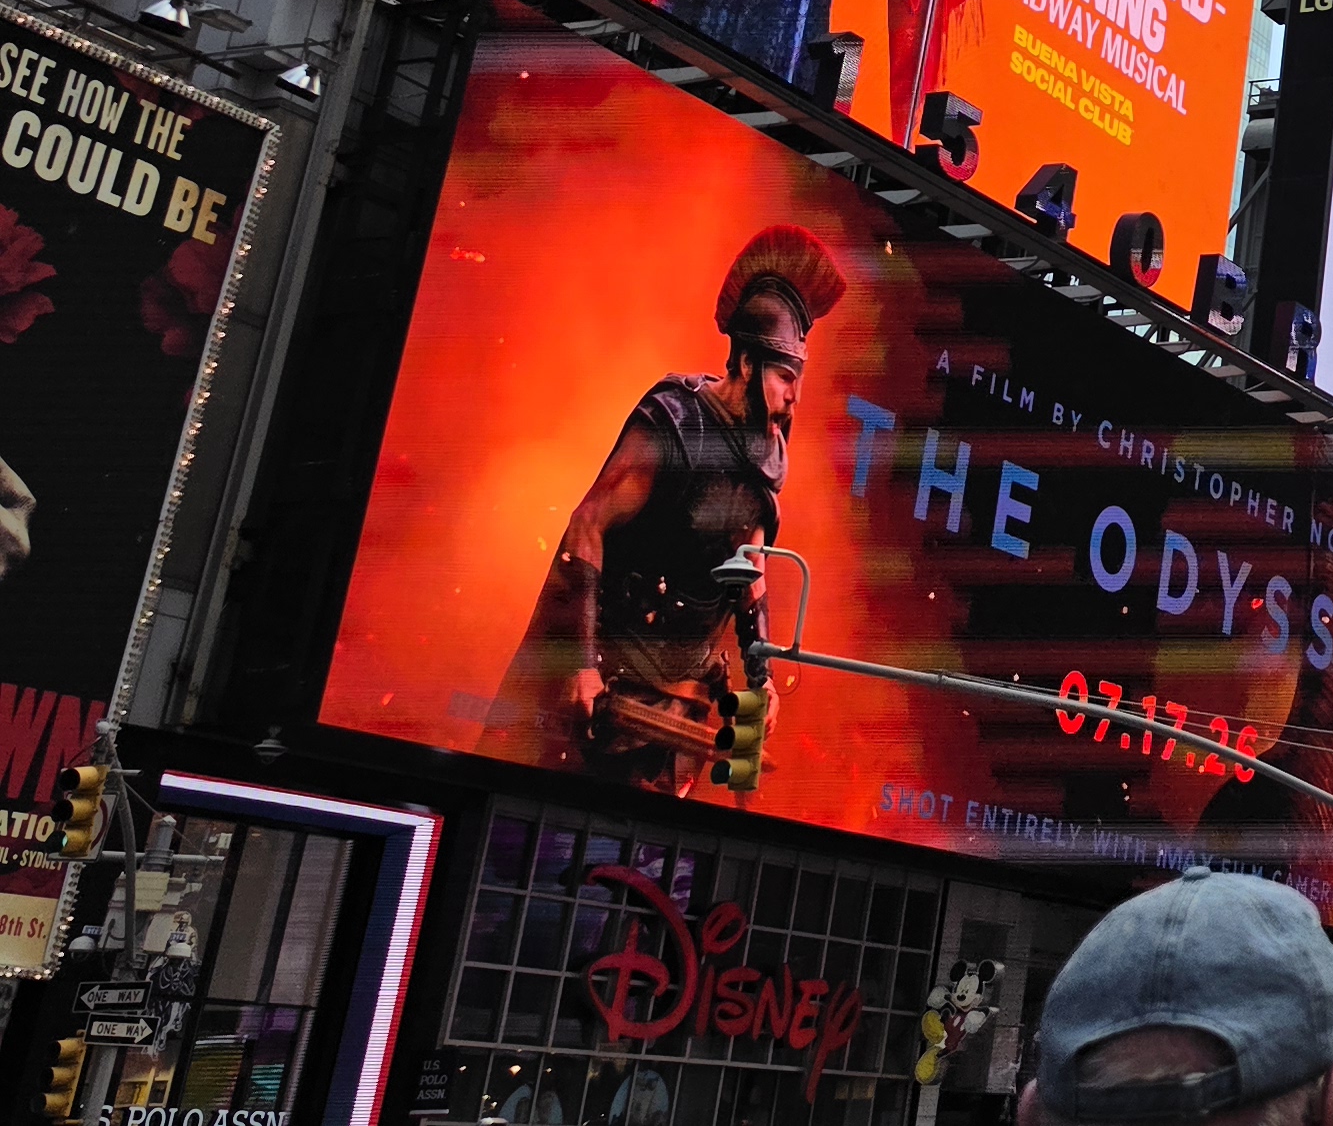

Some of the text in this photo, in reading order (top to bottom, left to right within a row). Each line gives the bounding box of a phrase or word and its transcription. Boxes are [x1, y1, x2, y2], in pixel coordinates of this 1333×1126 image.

[0, 42, 193, 161] SEE HOW THE
[1009, 50, 1132, 147] SOCIAL CLUB
[1013, 24, 1134, 123] BUENA VISTA
[1102, 26, 1188, 116] MUSICAL
[2, 109, 228, 246] COULD BE
[808, 30, 1166, 289] 1540
[846, 394, 1040, 560] THE
[936, 348, 950, 375] A
[972, 364, 1035, 413] FILM
[1052, 401, 1083, 433] BY
[1097, 419, 1296, 534] CHRISTOPHER
[880, 782, 954, 822] SHOT
[966, 800, 1083, 852] ENTIRELY
[1092, 826, 1148, 864] WITH
[27, 922, 47, 940] St.
[87, 990, 141, 1003] ONE WAY
[96, 1023, 147, 1036] ONE WAY
[419, 1073, 448, 1086] POLO
